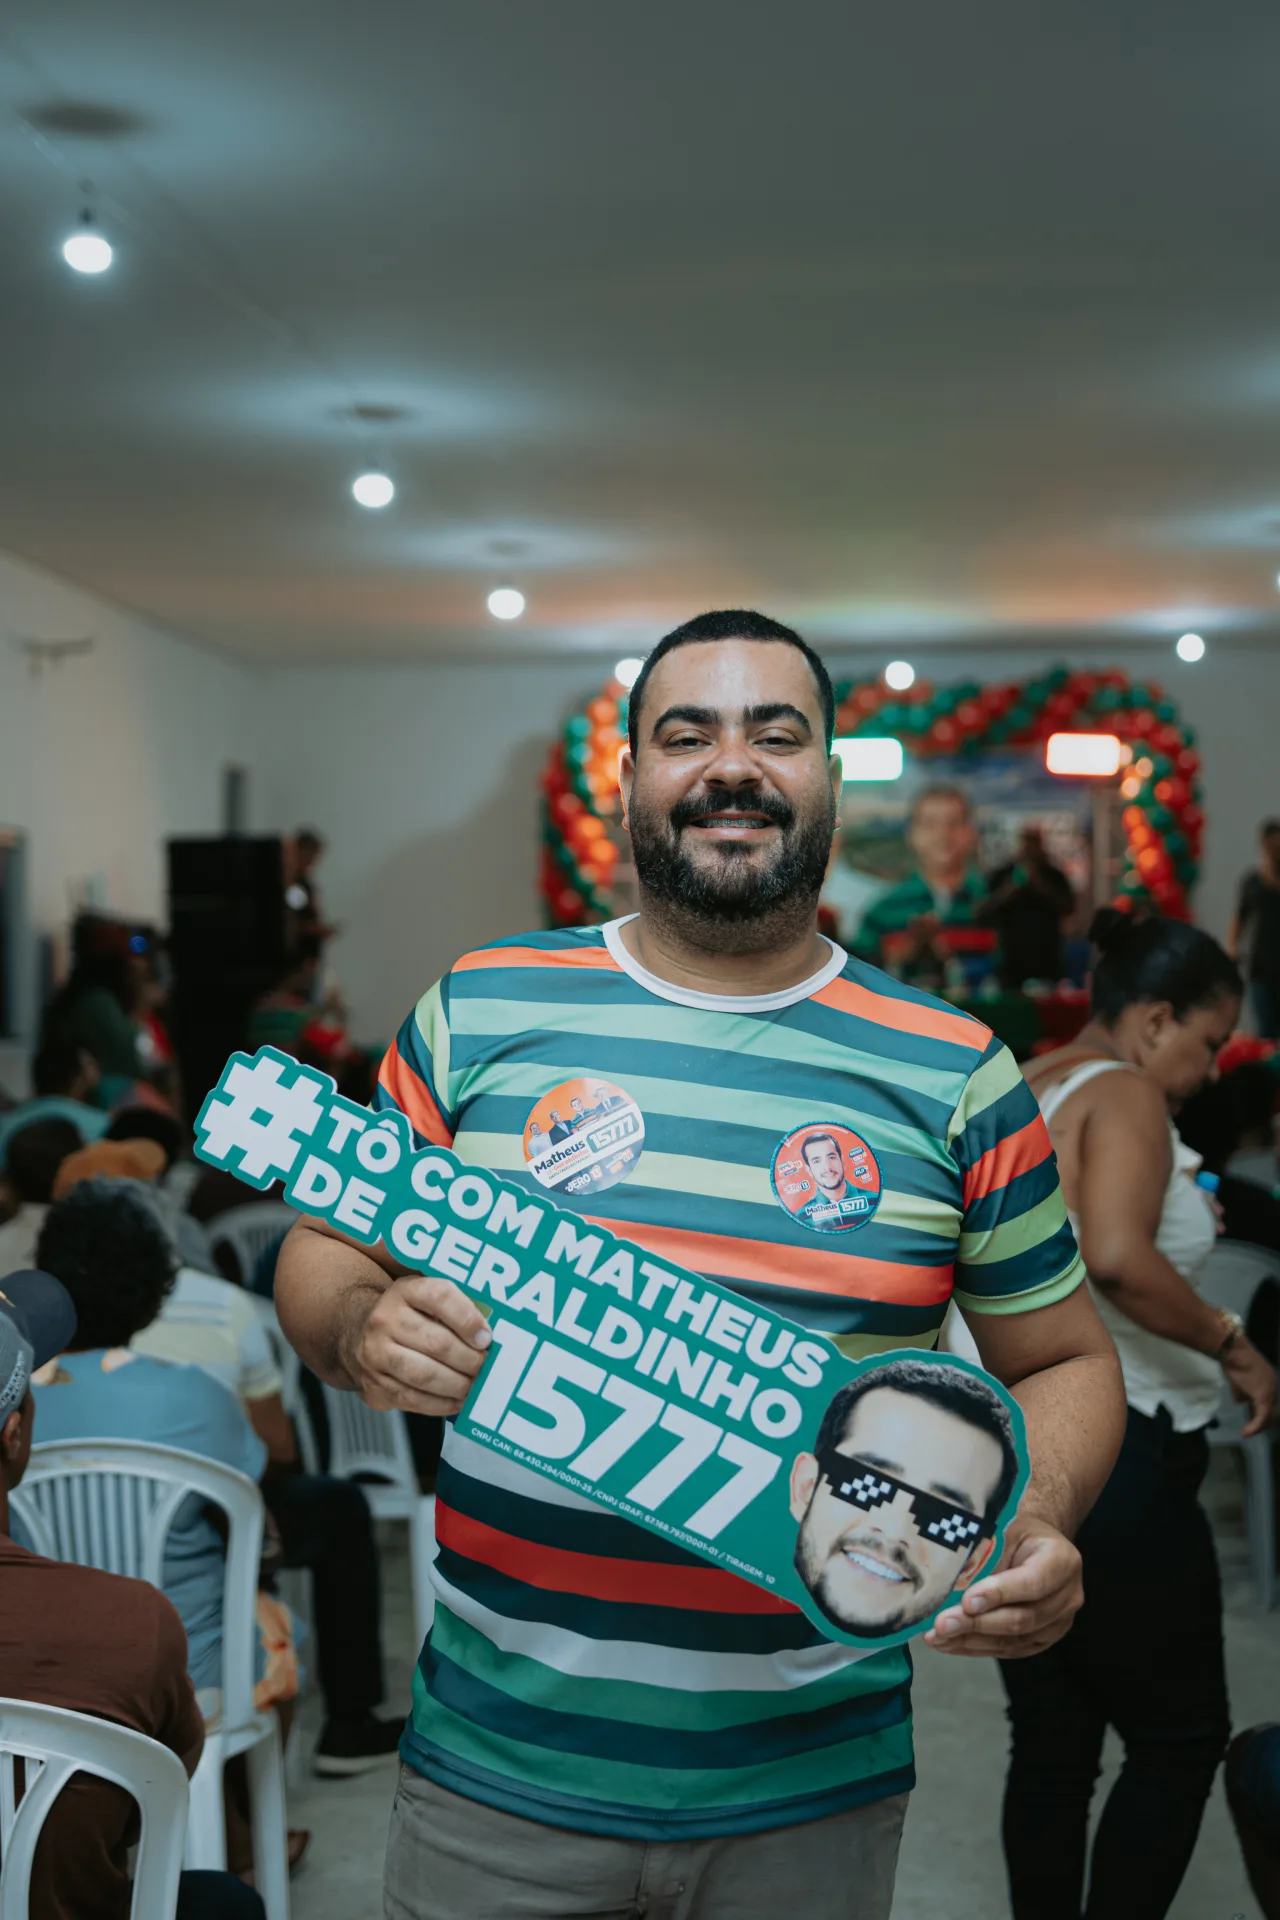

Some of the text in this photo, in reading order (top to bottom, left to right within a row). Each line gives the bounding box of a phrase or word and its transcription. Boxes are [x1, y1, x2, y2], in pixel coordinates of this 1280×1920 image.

[534, 1140, 586, 1174] Matheus
[588, 1115, 635, 1150] 15777
[806, 1204, 838, 1215] Matheus
[840, 1198, 865, 1212] 15777
[291, 1154, 803, 1439] DE GERALDINHO
[410, 1156, 545, 1249] COM
[544, 1221, 830, 1388] MATHEUS
[468, 1317, 783, 1541] 15777
[471, 1427, 492, 1442] CNPJ
[492, 1438, 513, 1453] CAN:
[618, 1501, 644, 1519] GRAF:
[725, 1553, 764, 1579] TIRAGEM:
